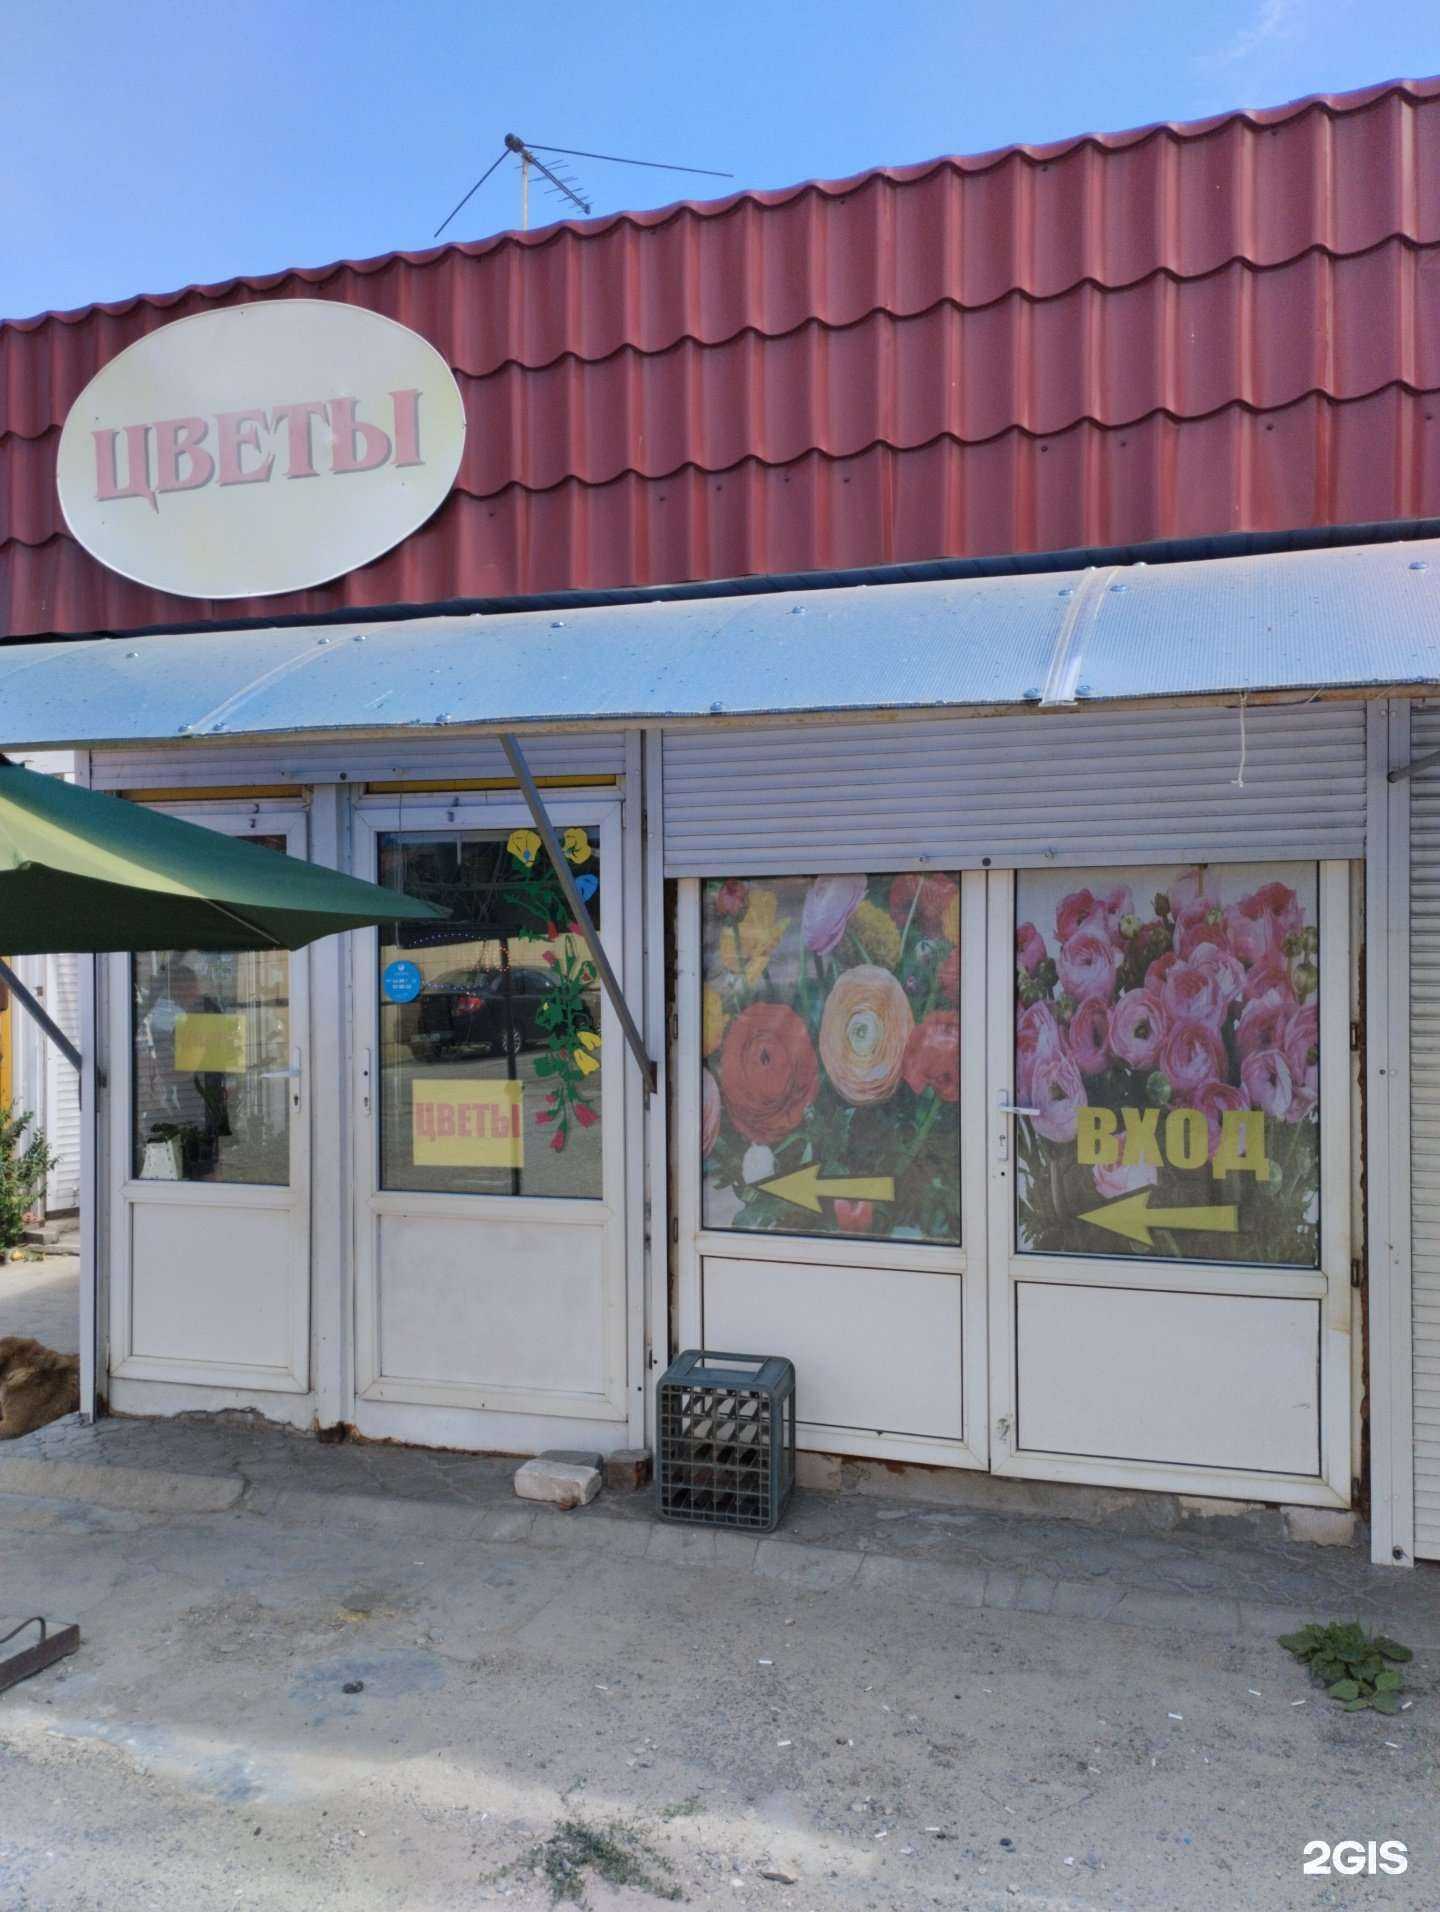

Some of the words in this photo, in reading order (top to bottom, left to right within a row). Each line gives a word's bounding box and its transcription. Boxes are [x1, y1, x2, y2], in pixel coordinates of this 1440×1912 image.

[91, 388, 425, 514] ЦВЕТЫ
[415, 1103, 520, 1142] ЦВЕТЫ
[1076, 1106, 1270, 1182] ВХОД
